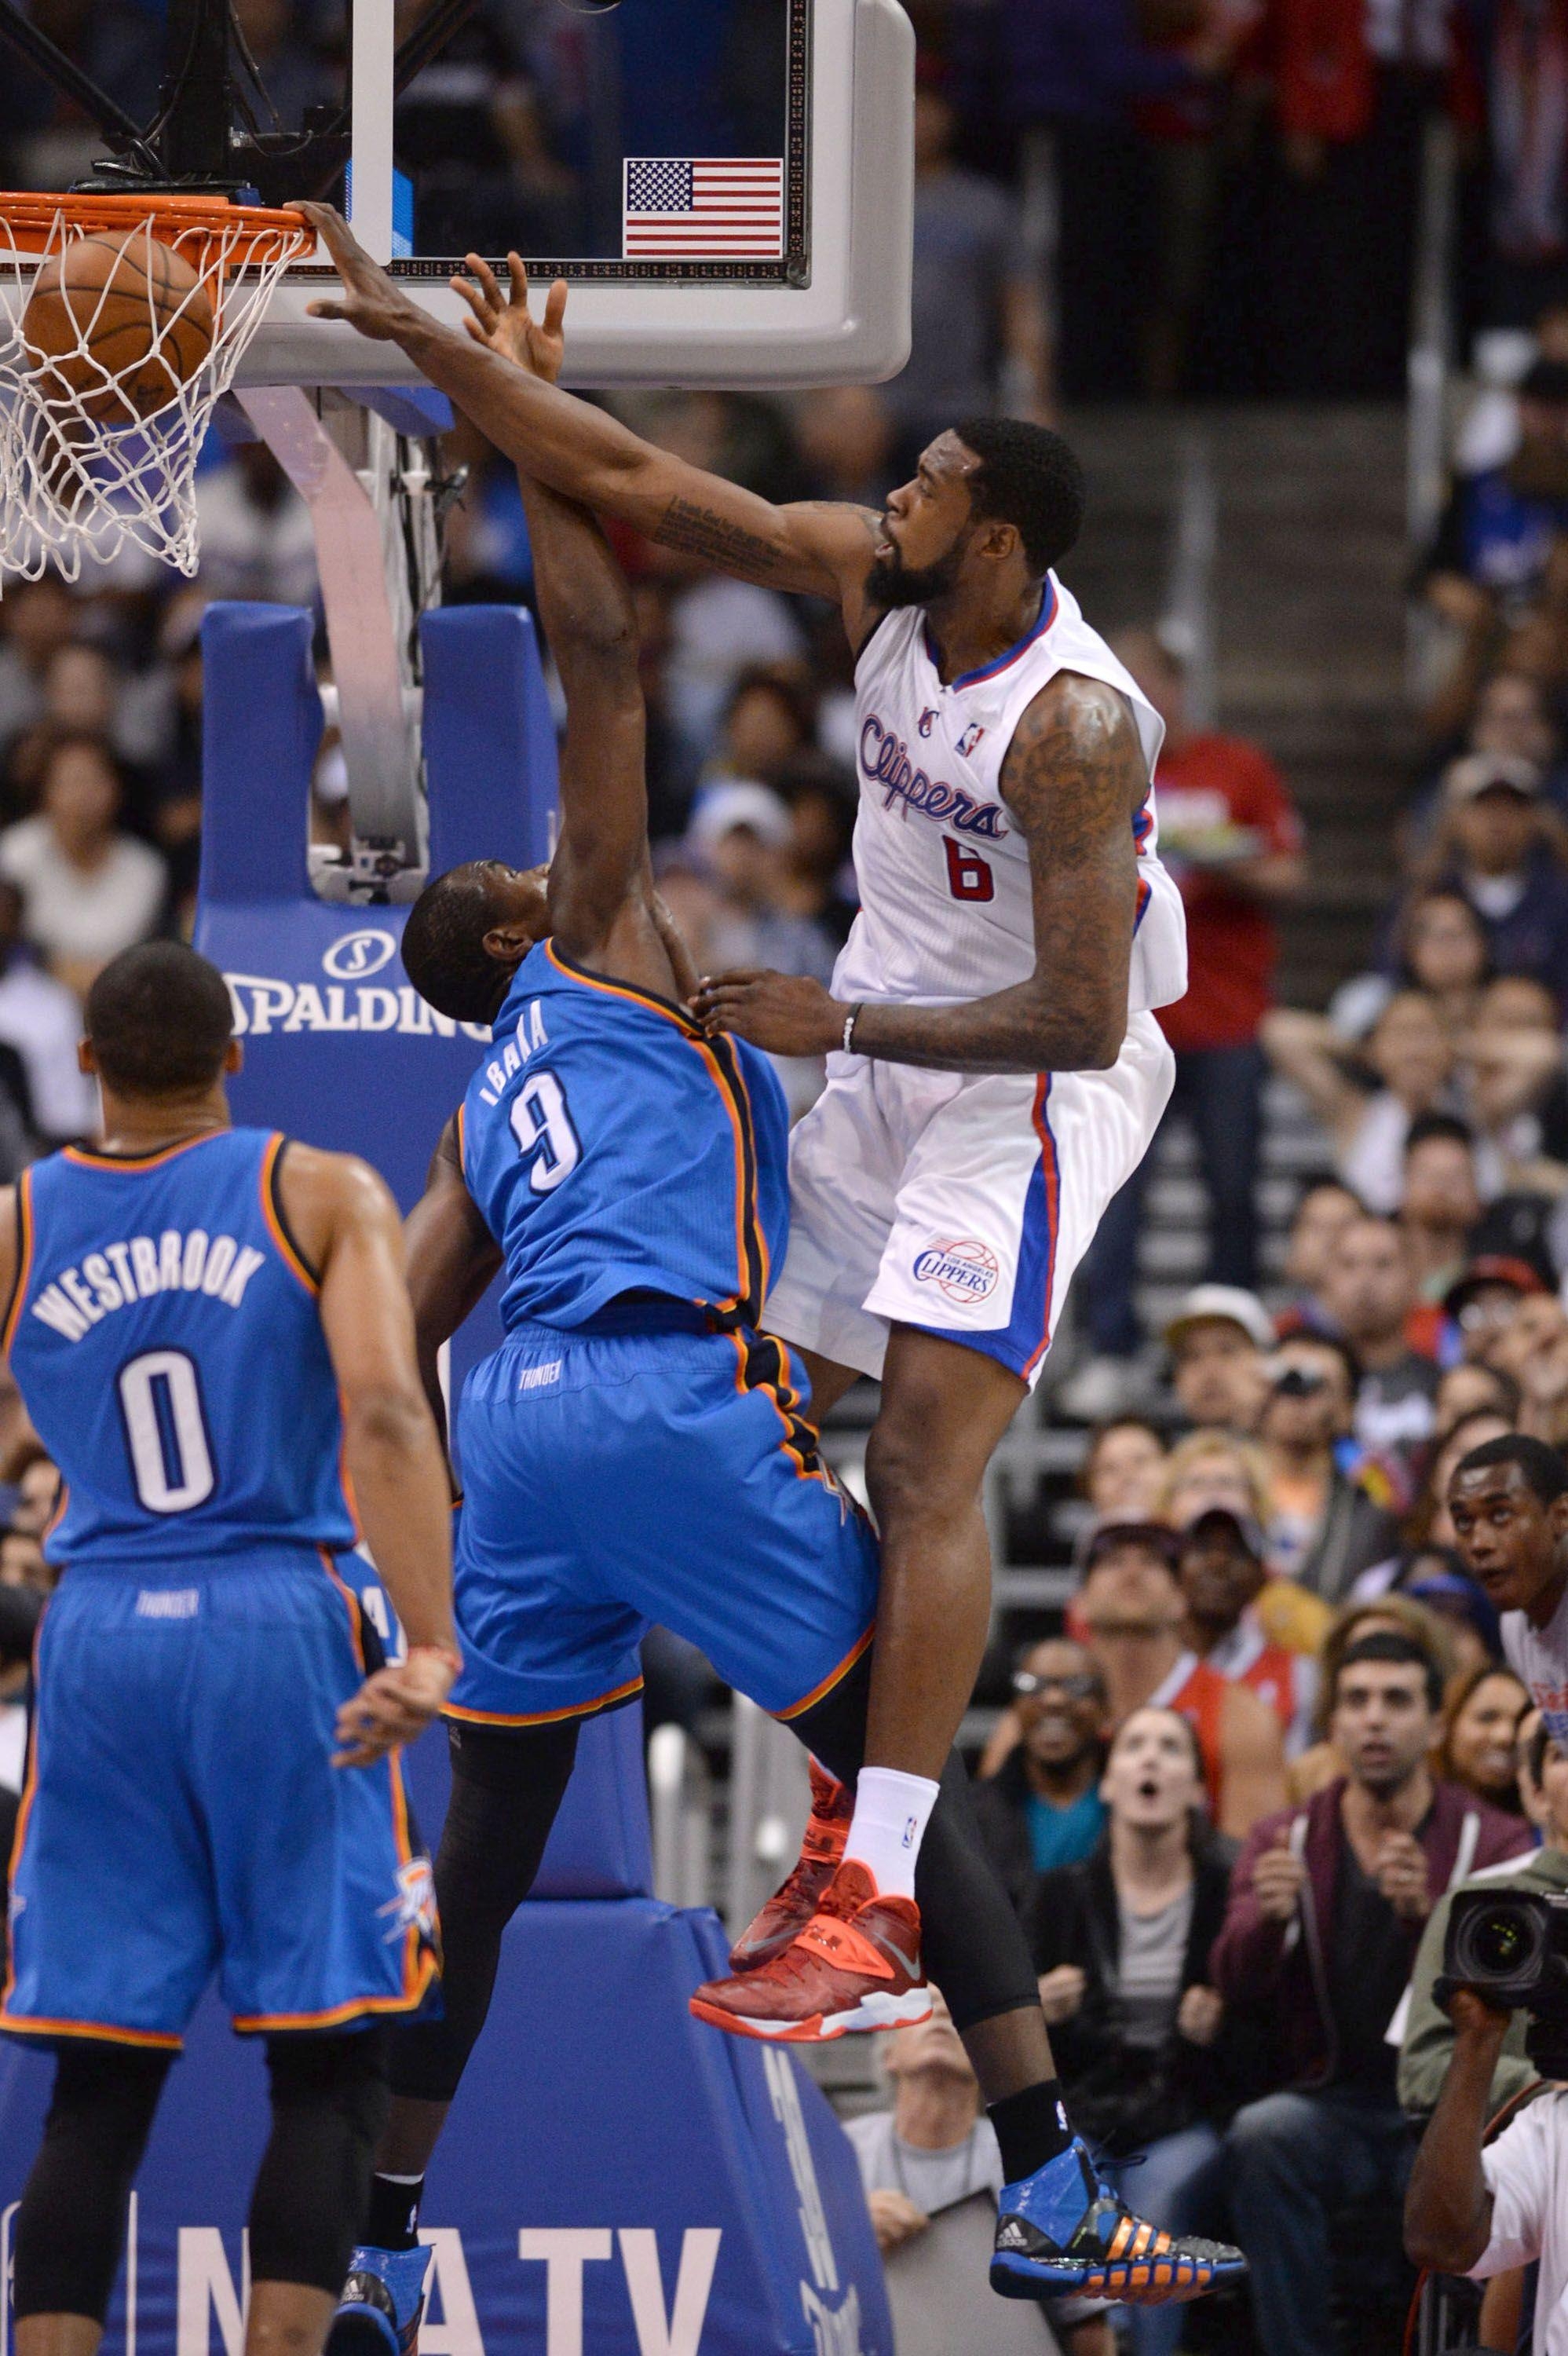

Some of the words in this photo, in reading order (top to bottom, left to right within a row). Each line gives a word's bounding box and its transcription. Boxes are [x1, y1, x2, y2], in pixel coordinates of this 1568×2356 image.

[860, 713, 1008, 840] Clippers
[942, 835, 996, 902] 6
[509, 1067, 584, 1197] 9
[31, 1228, 266, 1344] WESTBROOK
[914, 1250, 989, 1293] CLIPPERS
[115, 1346, 219, 1516] 0
[177, 2227, 487, 2356] NA
[517, 2227, 723, 2356] TV
